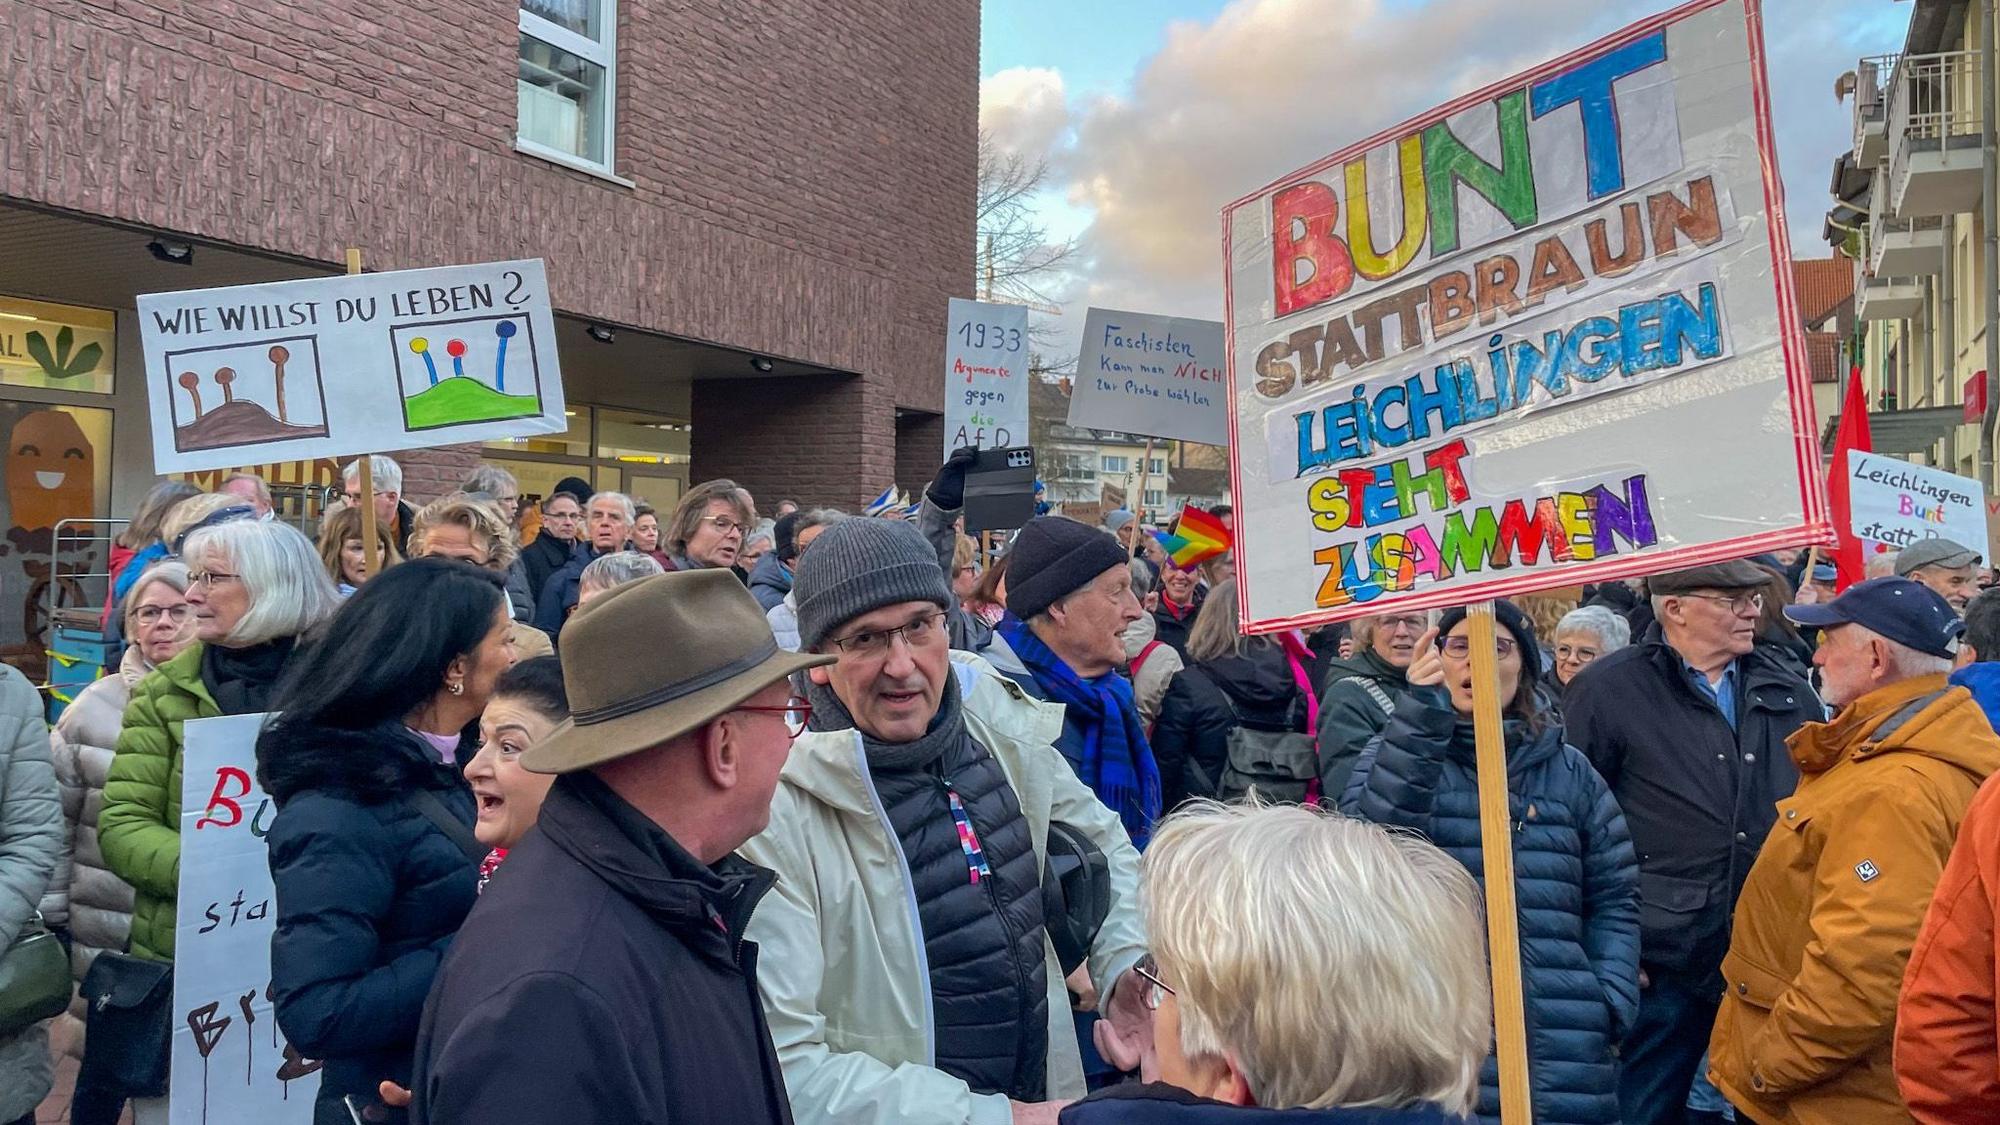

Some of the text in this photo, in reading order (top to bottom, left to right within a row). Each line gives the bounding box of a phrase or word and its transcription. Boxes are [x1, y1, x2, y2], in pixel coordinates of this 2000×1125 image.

[1272, 26, 1668, 318] BUNT
[153, 307, 213, 334] WIE
[217, 302, 321, 331] WILLST
[336, 297, 376, 323] DU
[958, 321, 1021, 352] 1933
[1104, 324, 1196, 358] Faschisten
[954, 358, 1011, 383] Argumente
[1141, 365, 1165, 374] man
[965, 390, 1004, 406] gegen
[1125, 379, 1159, 397] Probe
[1167, 389, 1210, 406] wählen
[971, 411, 994, 426] die
[953, 425, 1011, 450] AfD
[1308, 439, 1471, 532] STEHT
[1854, 459, 1973, 507] Leichlingen
[1898, 493, 1946, 524] Bunt
[1314, 474, 1658, 608] ZUSAMMEN
[1861, 522, 1918, 546] statt
